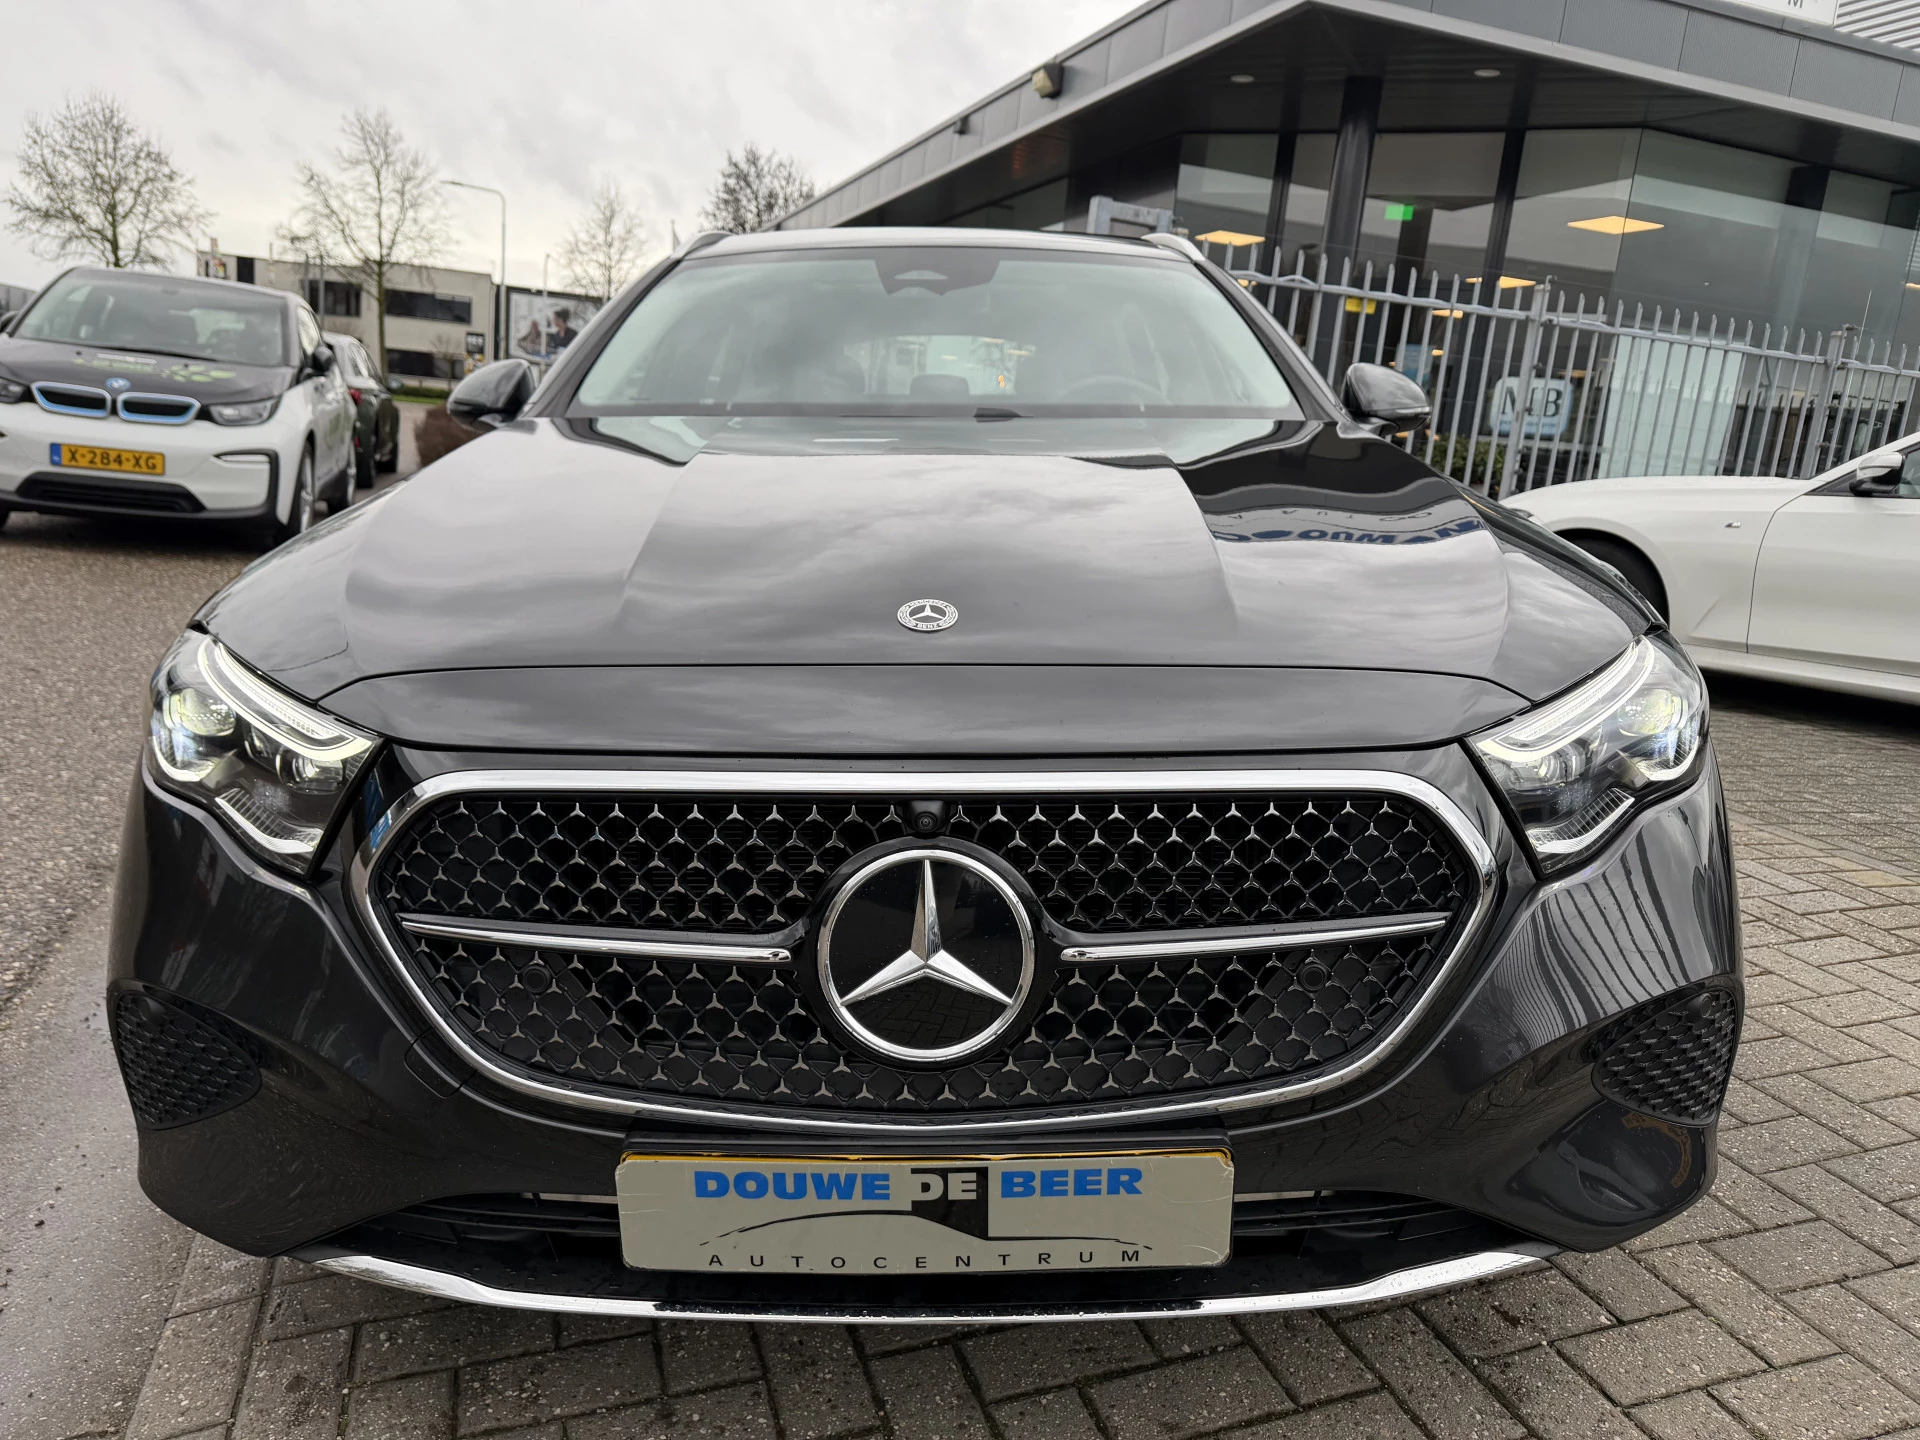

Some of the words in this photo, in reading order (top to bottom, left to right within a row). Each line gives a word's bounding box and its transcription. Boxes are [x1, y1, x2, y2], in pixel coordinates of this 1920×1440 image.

[67, 447, 157, 470] X-284-XG
[695, 1171, 890, 1200] DOUWE
[917, 1172, 978, 1201] DE
[1001, 1168, 1142, 1198] BEER
[709, 1250, 1139, 1268] AUTOCENTRUM
